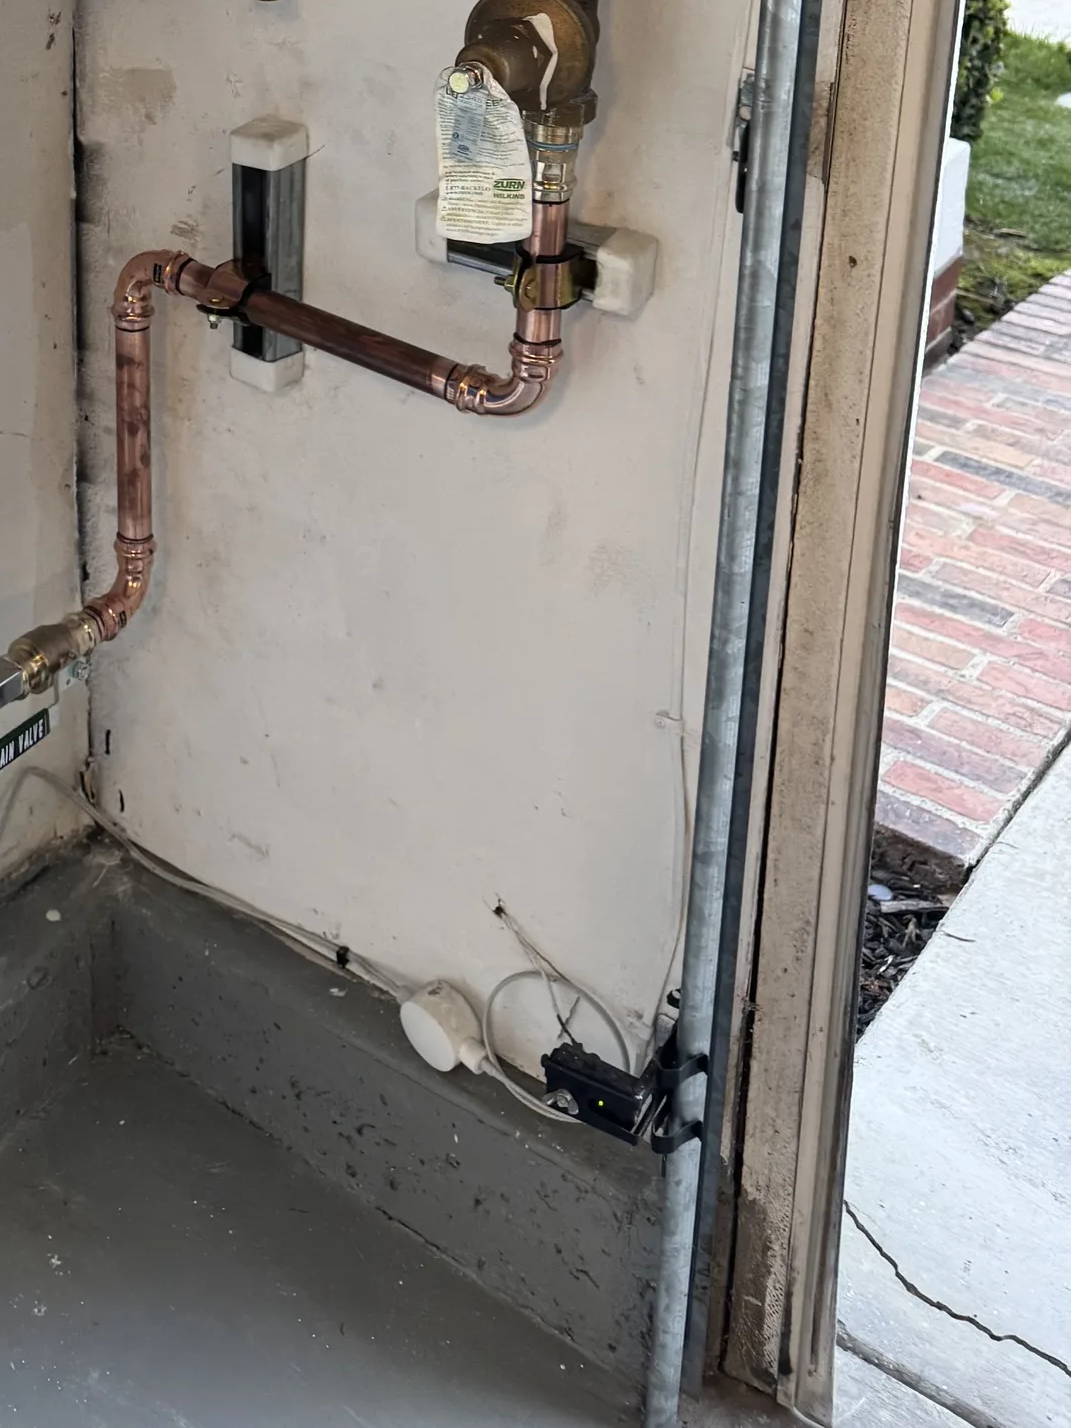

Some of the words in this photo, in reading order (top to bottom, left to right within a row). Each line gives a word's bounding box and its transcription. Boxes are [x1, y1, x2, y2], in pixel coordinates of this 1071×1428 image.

[493, 180, 525, 190] ZURN
[493, 192, 525, 200] WILKINS
[19, 718, 44, 754] VALVE
